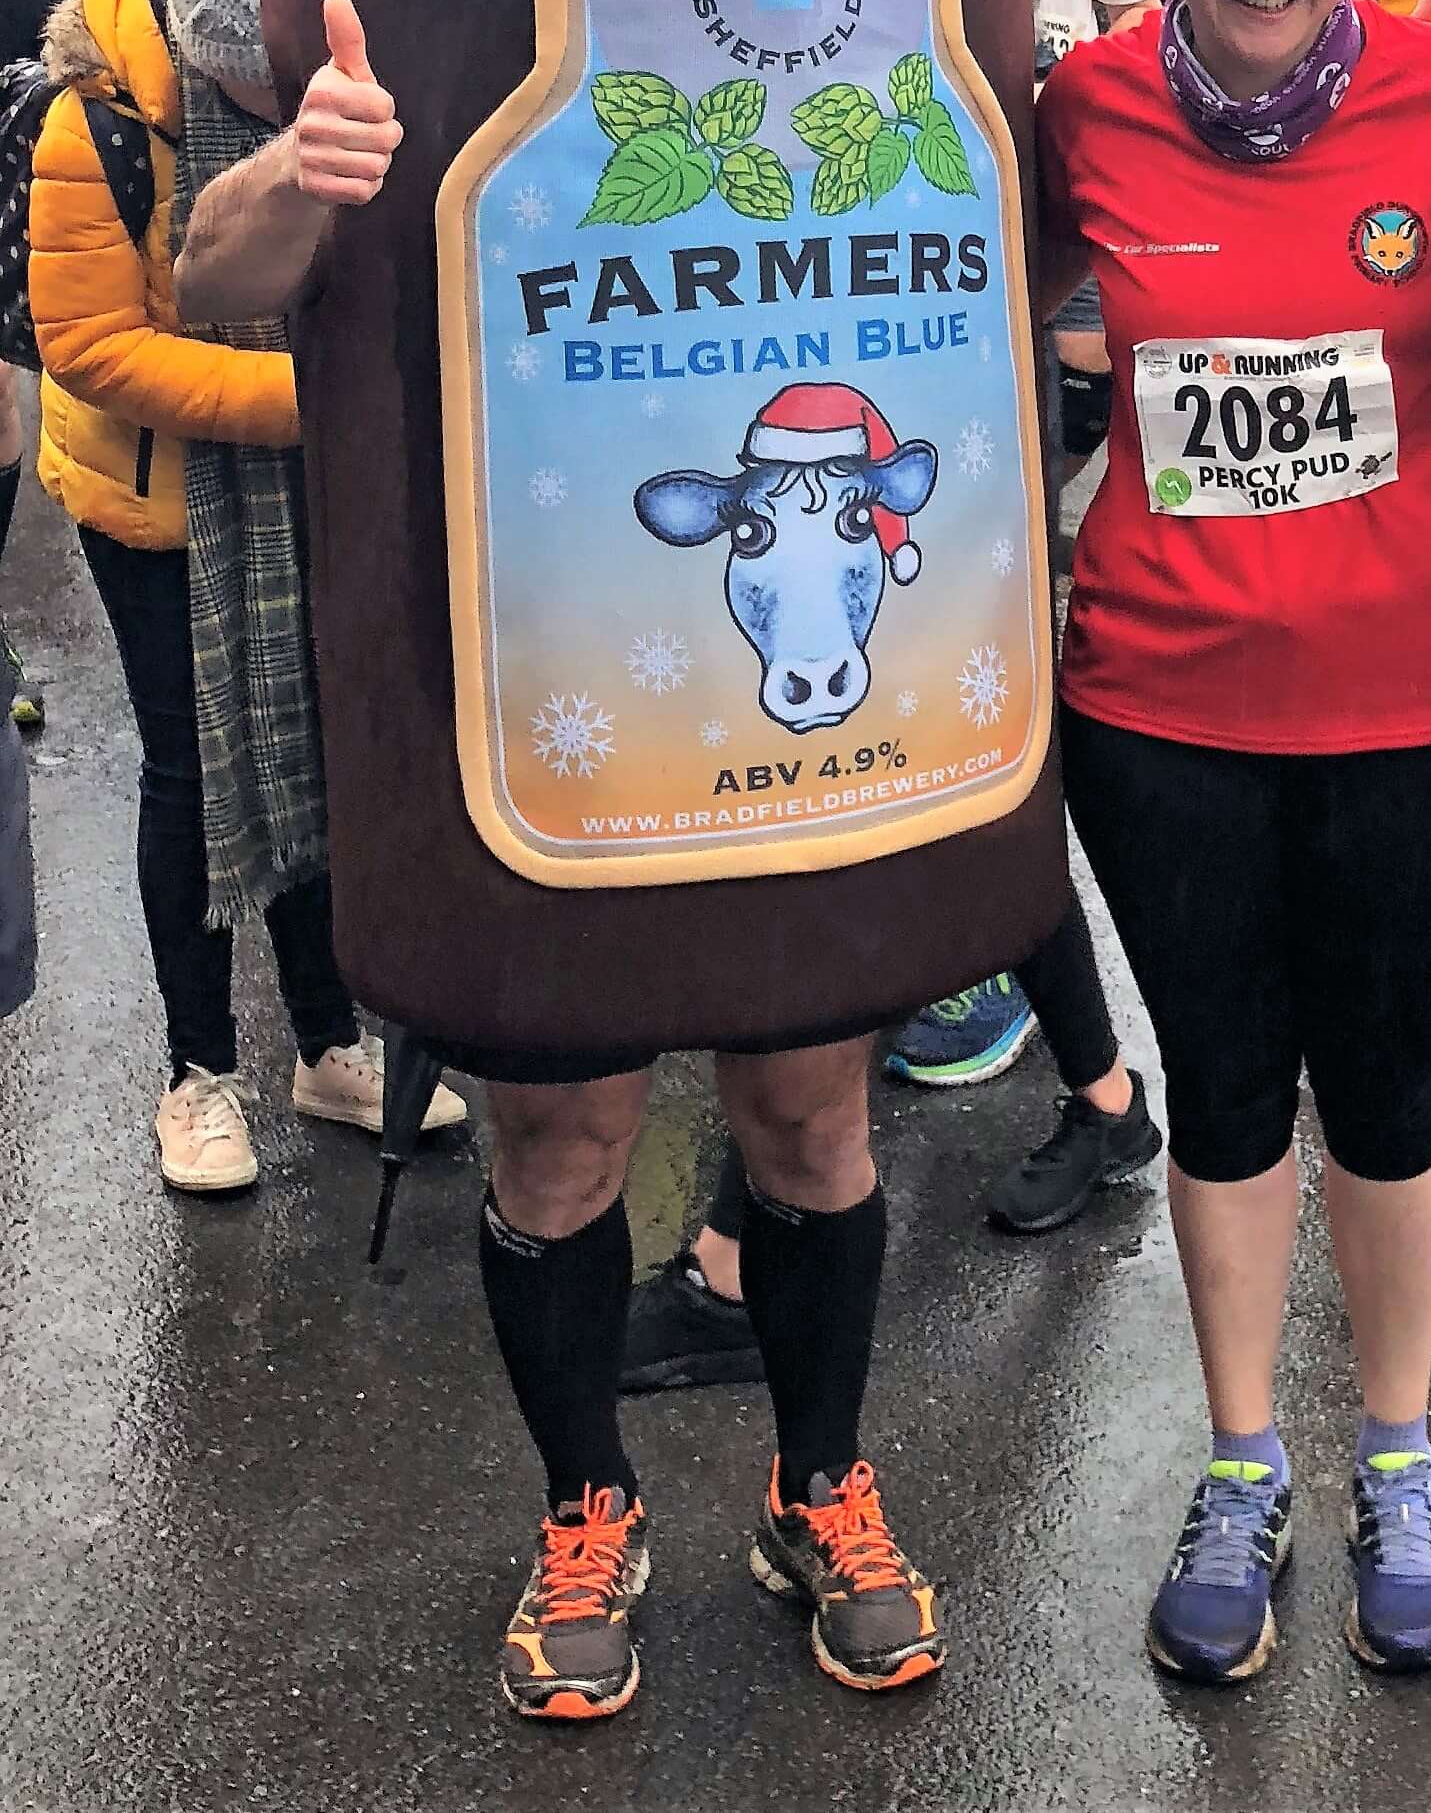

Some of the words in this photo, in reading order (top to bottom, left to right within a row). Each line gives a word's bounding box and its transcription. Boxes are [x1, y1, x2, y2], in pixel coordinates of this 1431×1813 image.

[516, 230, 989, 336] FARMERS
[563, 331, 831, 382] BELGIAN
[856, 311, 970, 362] BLUE
[1179, 353, 1209, 374] UP
[1235, 346, 1340, 376] RUNNING
[1174, 375, 1358, 462] 2084
[1199, 463, 1281, 489] PERCY
[1292, 452, 1350, 480] PUD
[1249, 483, 1301, 510] 10K
[581, 747, 1003, 834] WWW.BRADFIELDBREWERY.COM
[712, 761, 803, 795] ABV
[818, 738, 908, 780] 4.9%
